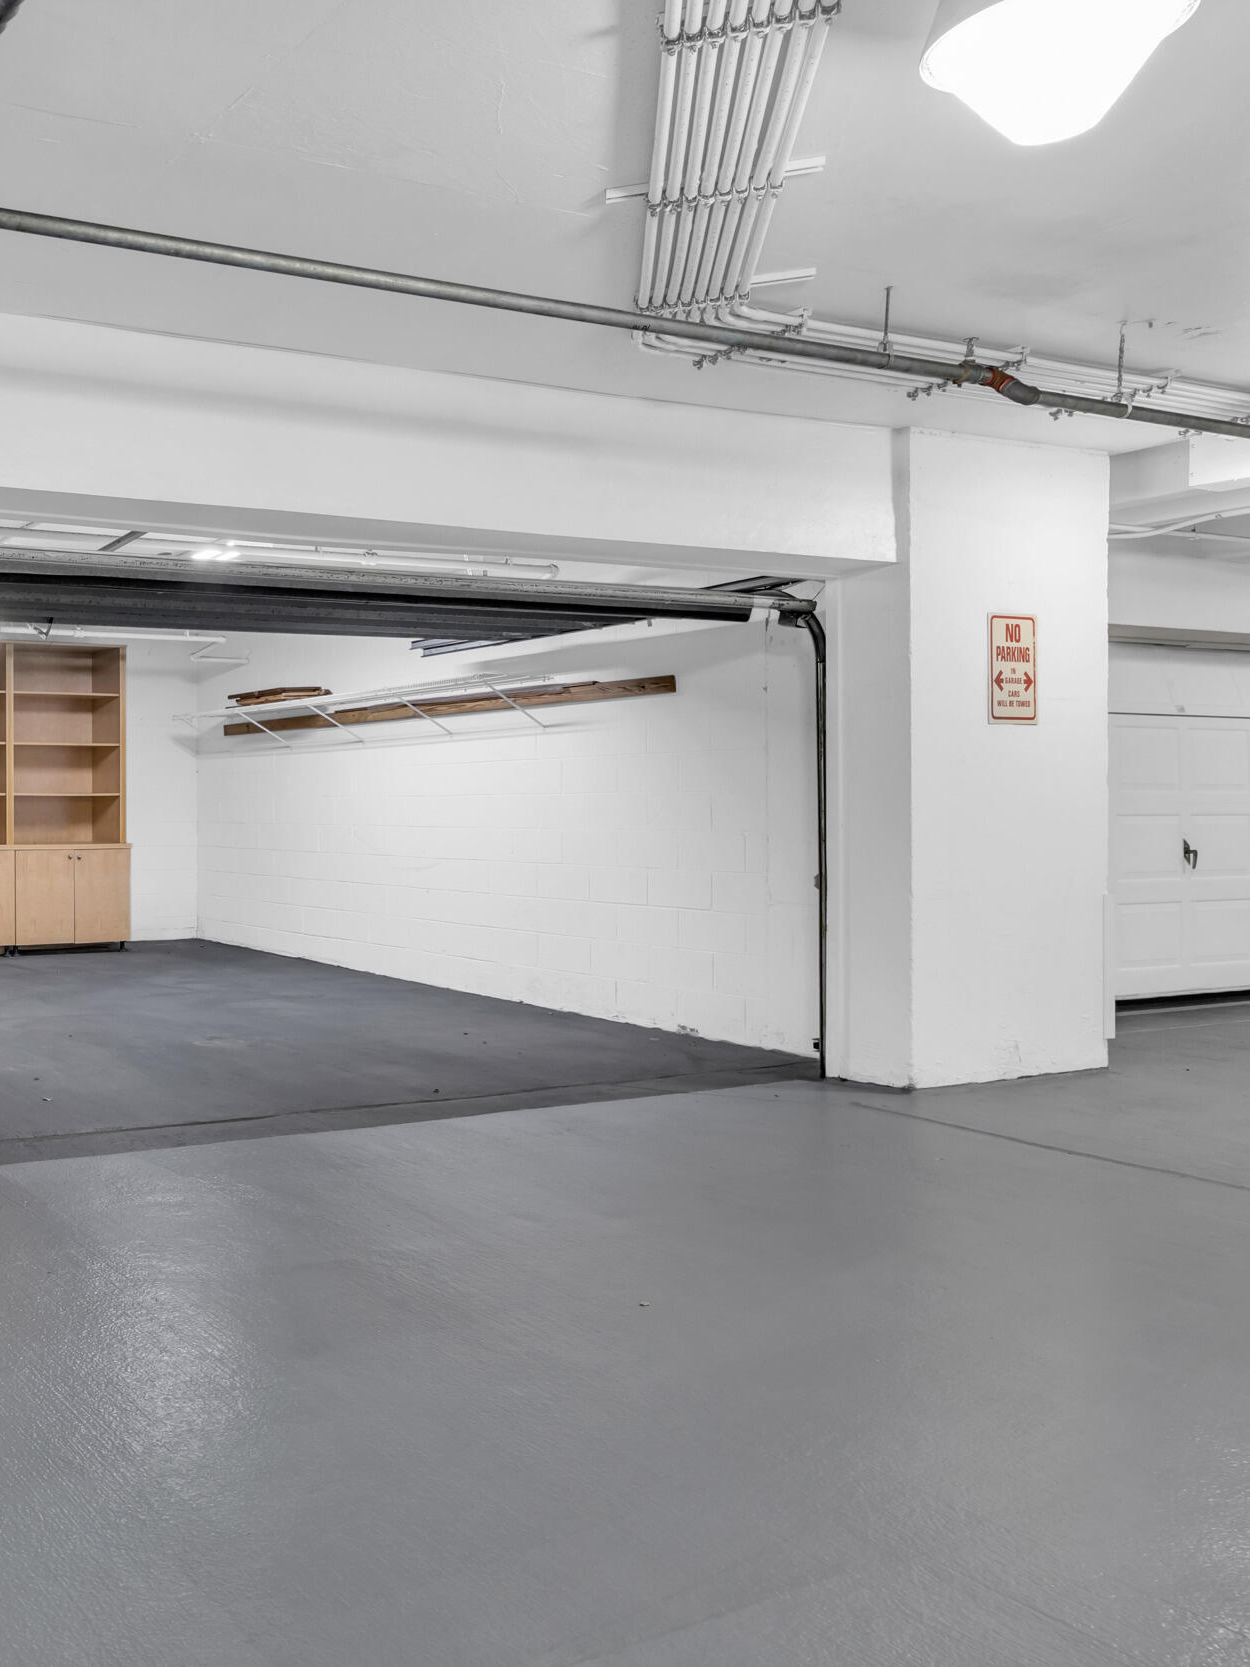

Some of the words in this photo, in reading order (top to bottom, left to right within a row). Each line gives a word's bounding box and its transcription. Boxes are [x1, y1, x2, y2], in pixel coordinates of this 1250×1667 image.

[1005, 623, 1021, 643] NO
[996, 646, 1030, 663] PARKING
[1005, 677, 1022, 685] GARAGE
[1008, 690, 1020, 698] CARS
[997, 699, 1008, 707] WILL
